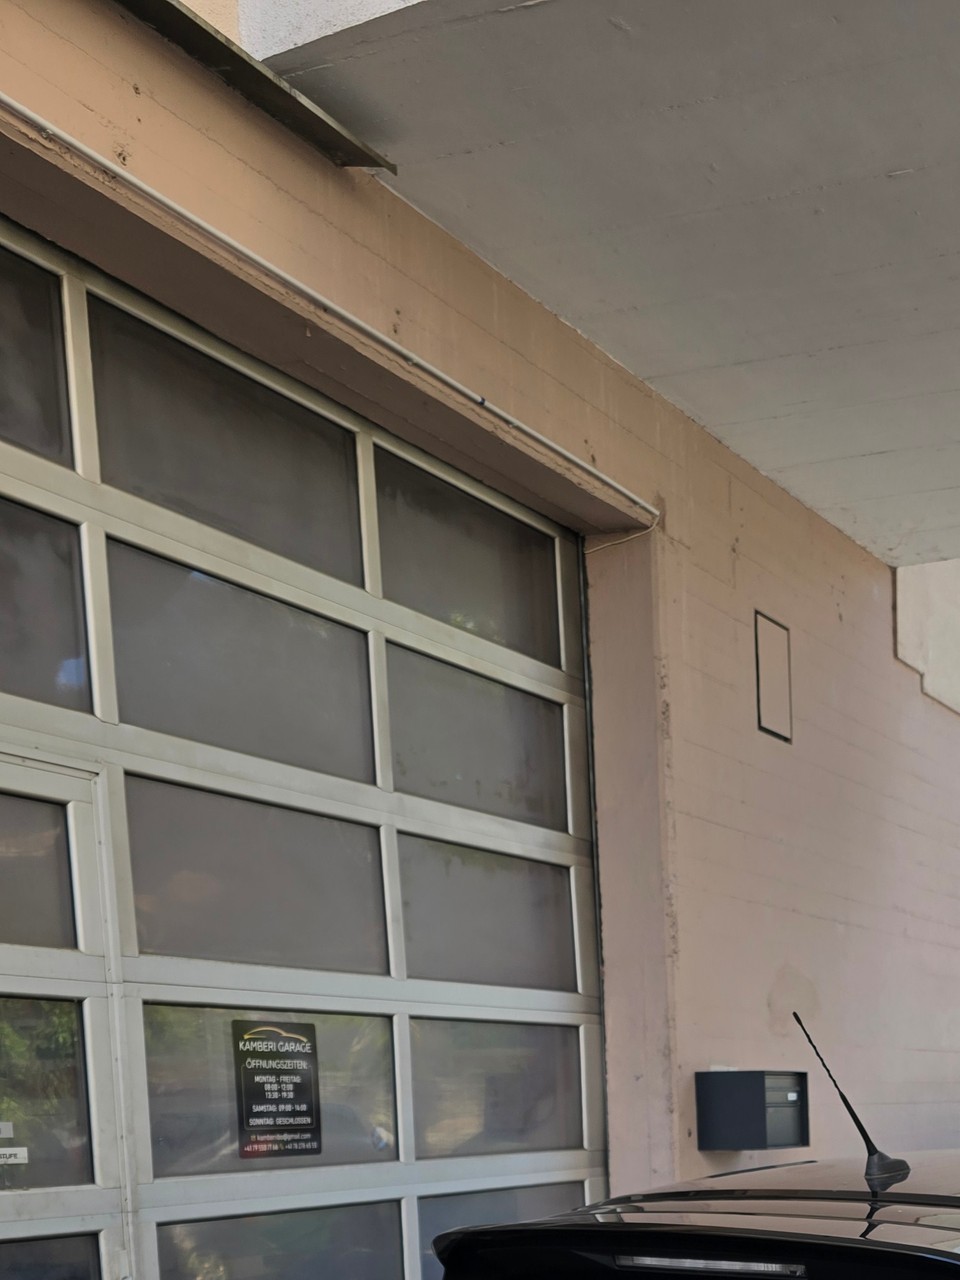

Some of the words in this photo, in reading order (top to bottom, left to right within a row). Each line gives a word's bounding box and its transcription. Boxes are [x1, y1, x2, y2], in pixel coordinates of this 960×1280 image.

[239, 1041, 276, 1052] KAMBERI
[277, 1042, 312, 1053] GARAGE
[245, 1057, 308, 1070] ÖFFNUNGSZEITEN:
[254, 1075, 276, 1083] MONTAG
[275, 1117, 311, 1125] GESCHLOSSEN
